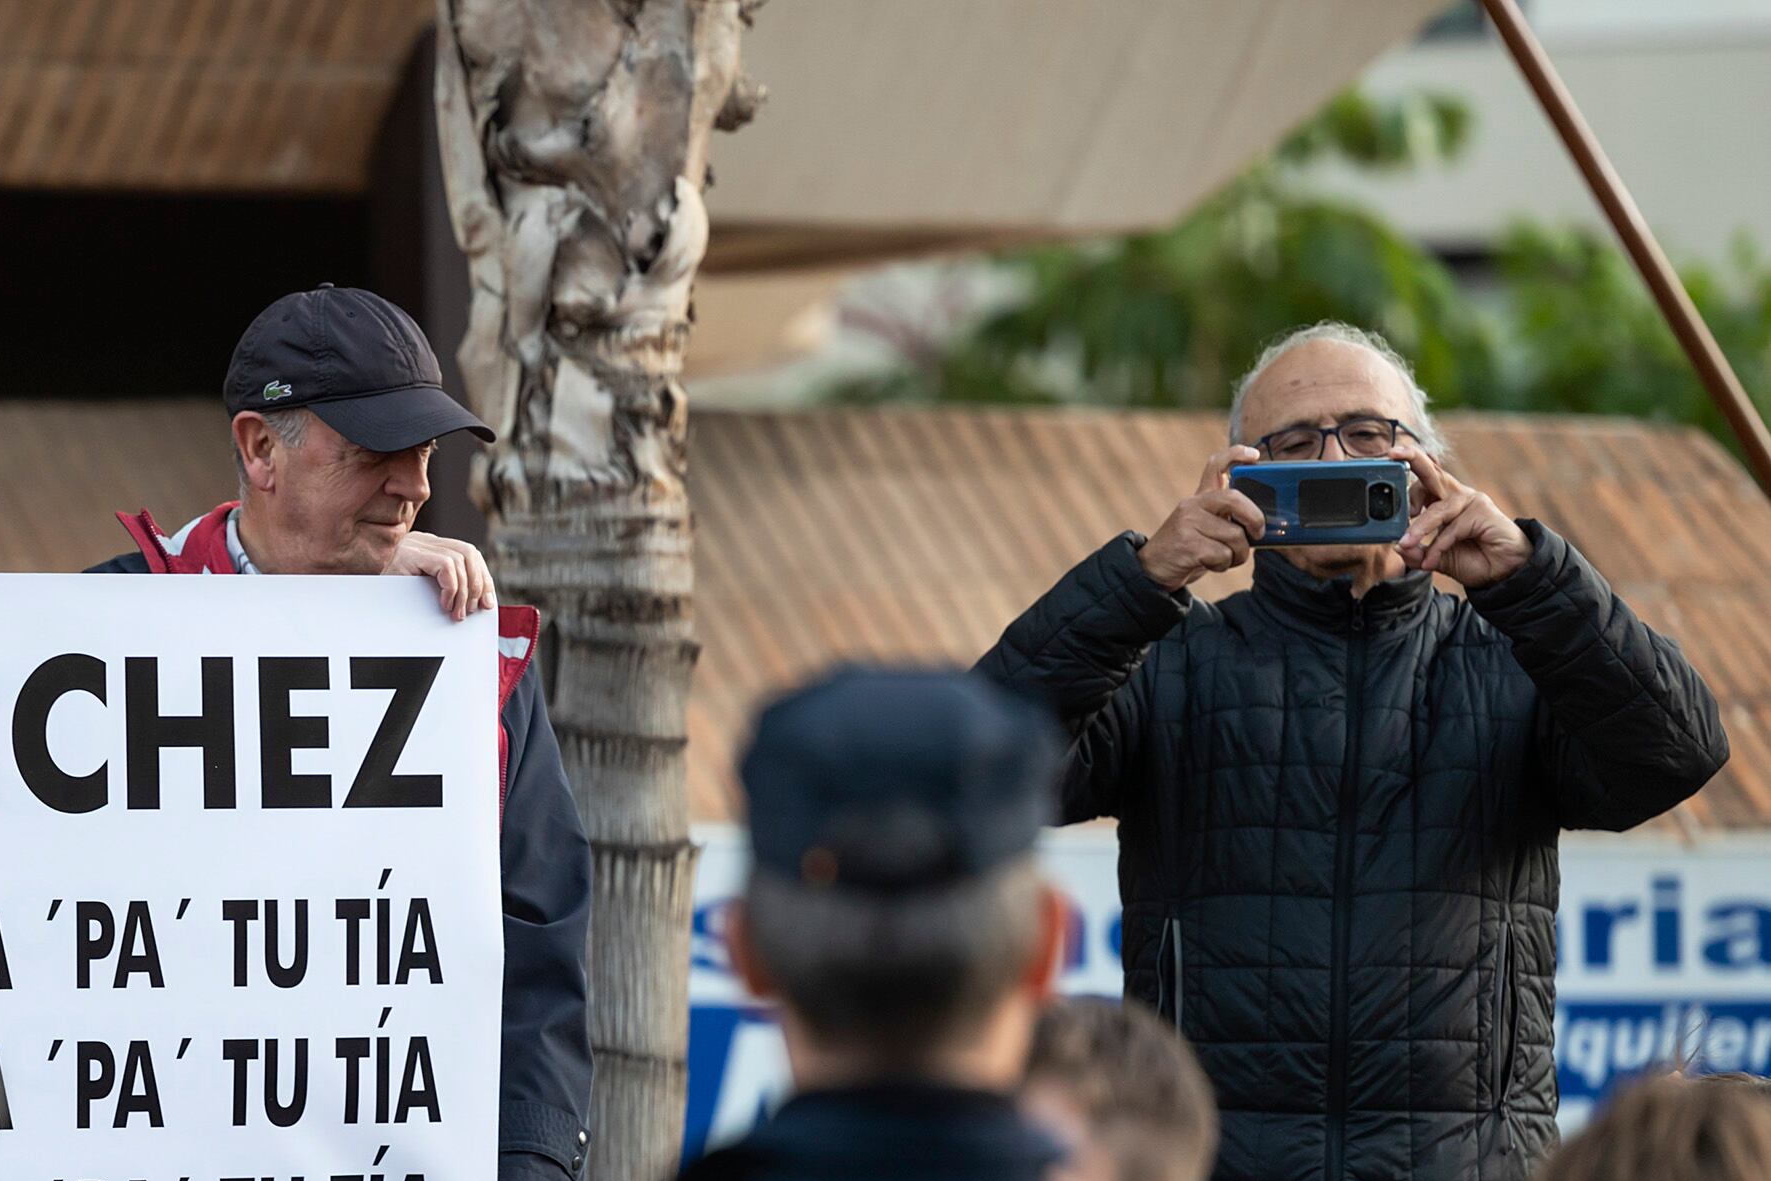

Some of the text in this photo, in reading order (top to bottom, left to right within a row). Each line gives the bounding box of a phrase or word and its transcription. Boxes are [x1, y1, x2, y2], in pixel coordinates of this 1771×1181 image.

[222, 898, 309, 989] TU
[335, 868, 444, 986] TÍA
[222, 1037, 309, 1128] TU
[335, 1006, 442, 1125] TÍA
